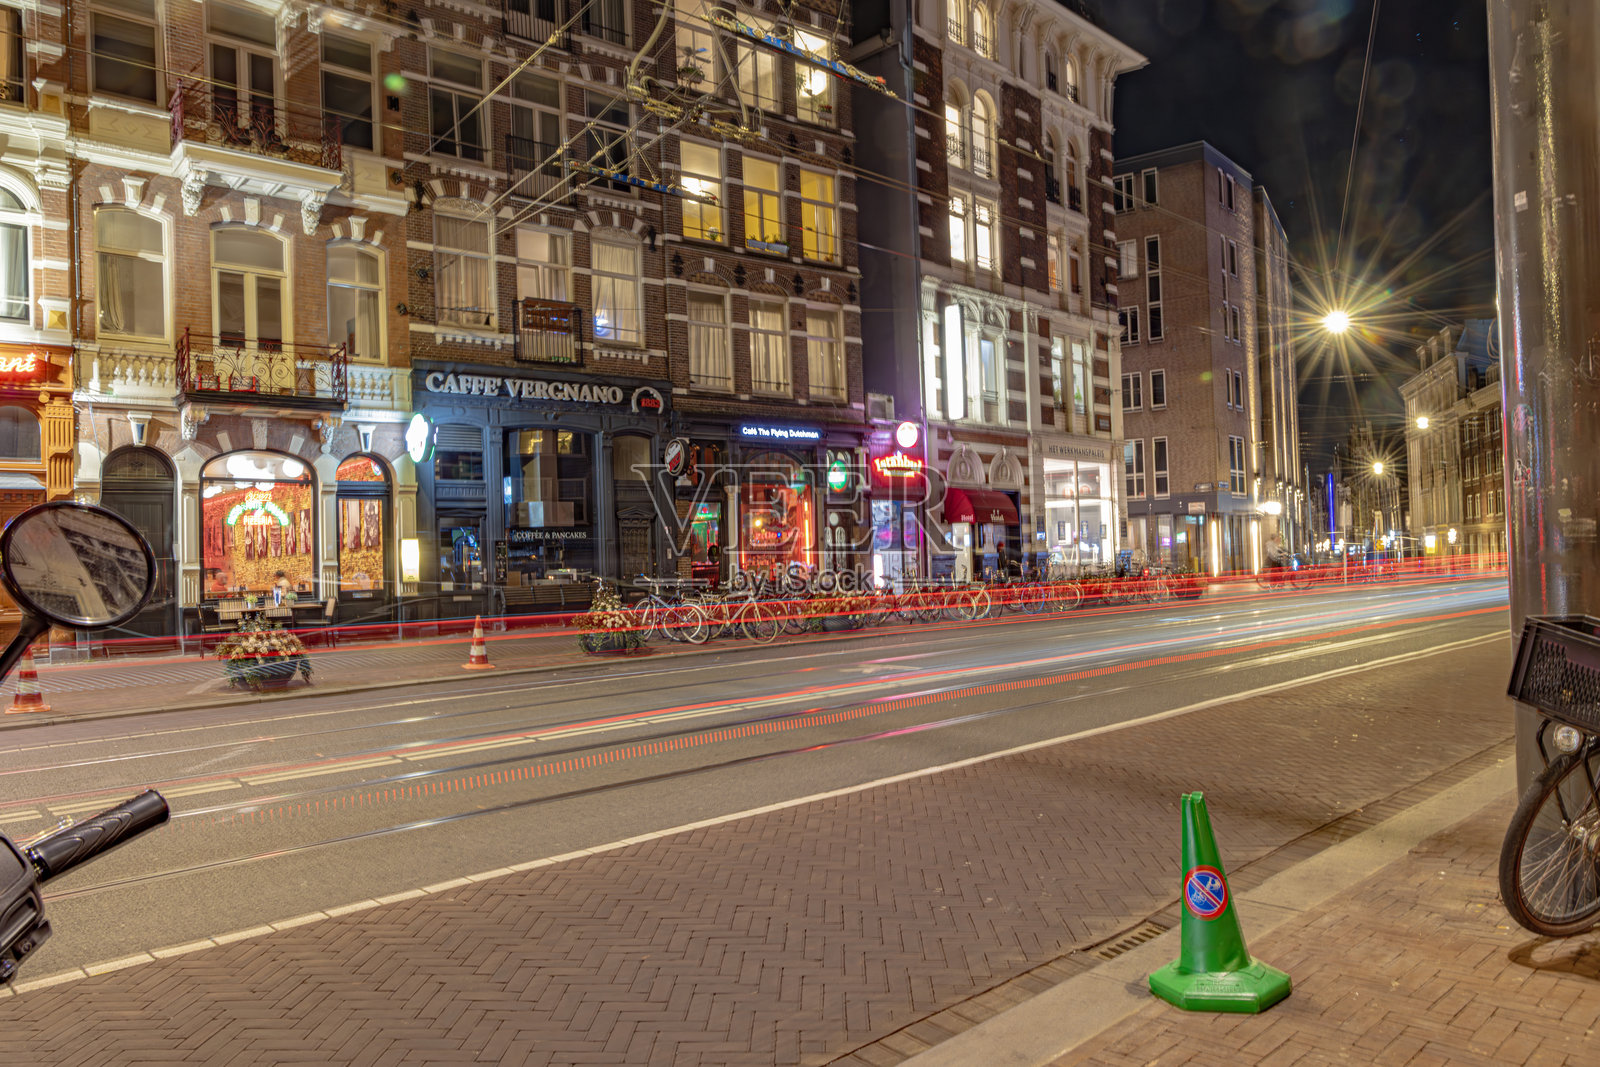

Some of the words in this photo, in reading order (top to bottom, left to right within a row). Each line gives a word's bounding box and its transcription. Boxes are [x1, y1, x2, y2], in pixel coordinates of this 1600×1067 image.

[504, 379, 624, 404] VERGNANO
[758, 428, 770, 436] The
[771, 428, 789, 438] Flying
[789, 429, 819, 438] Dutchman
[516, 530, 544, 540] COFFEE
[544, 531, 551, 539] &
[551, 531, 587, 540] PANCAKES
